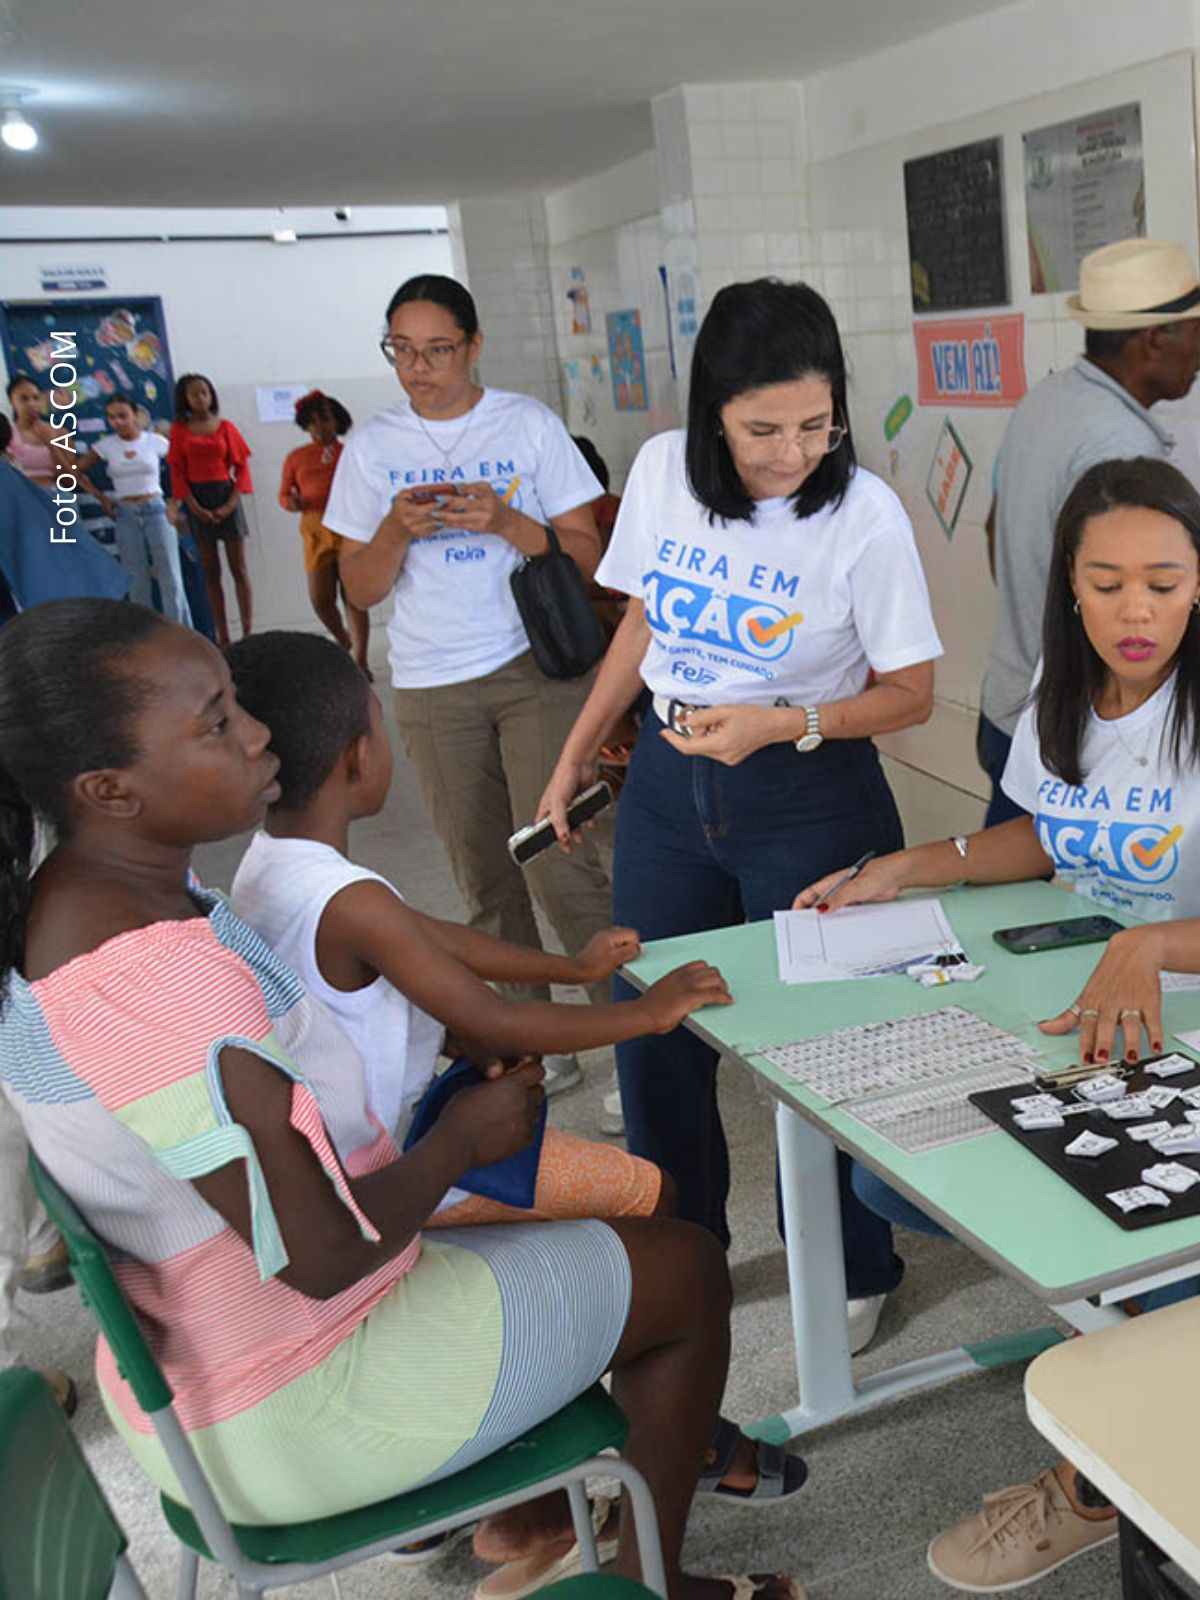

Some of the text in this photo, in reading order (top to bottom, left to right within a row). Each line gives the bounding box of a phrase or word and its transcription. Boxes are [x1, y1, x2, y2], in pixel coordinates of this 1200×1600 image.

[931, 323, 1001, 395] VEM AÍ!
[389, 459, 516, 485] FEIRA EM
[656, 536, 800, 598] EIRA EM
[1037, 779, 1173, 813] FEIRA EM
